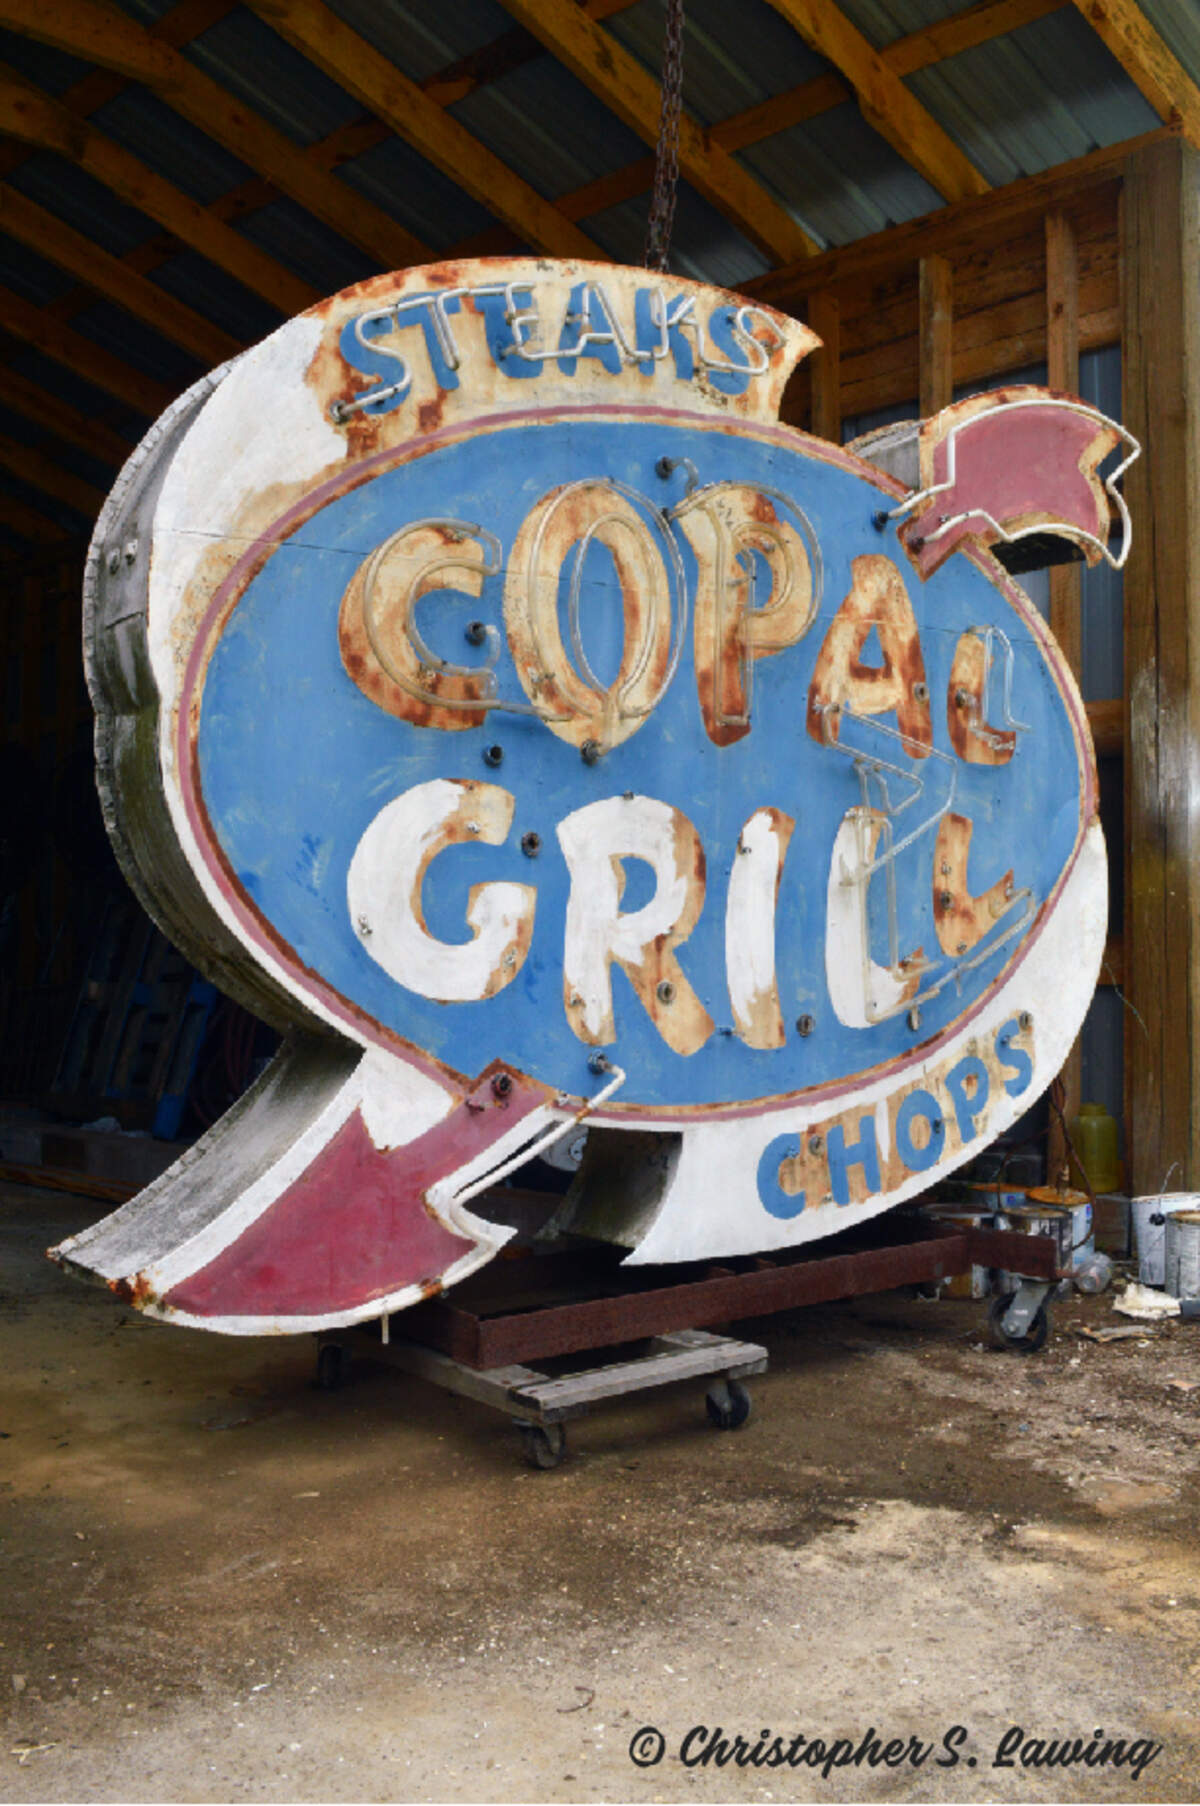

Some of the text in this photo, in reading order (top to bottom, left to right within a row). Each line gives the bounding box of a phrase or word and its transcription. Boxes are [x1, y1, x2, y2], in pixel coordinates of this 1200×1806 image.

[340, 281, 780, 415] STEAKS
[338, 479, 1018, 766] COPAL
[346, 778, 1016, 1057] GRILL
[756, 1017, 1034, 1221] CHOPS
